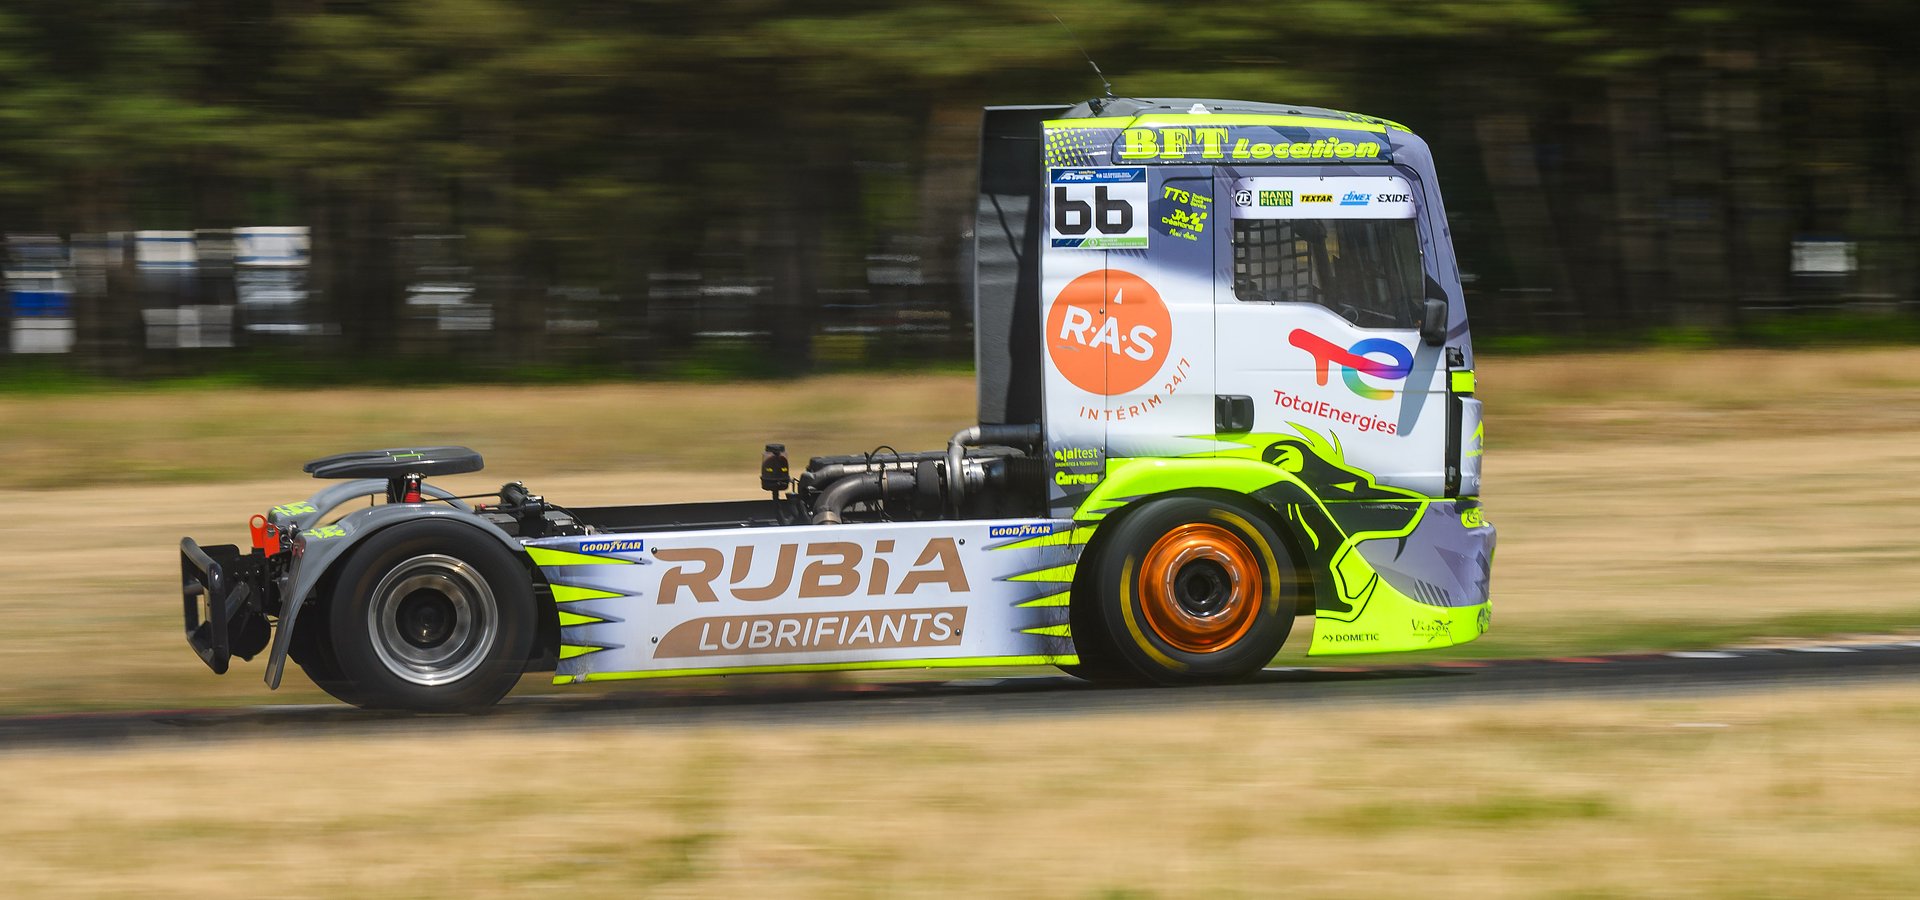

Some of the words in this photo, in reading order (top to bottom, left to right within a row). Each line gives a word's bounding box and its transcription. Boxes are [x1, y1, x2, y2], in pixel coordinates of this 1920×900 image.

[1121, 128, 1230, 159] BFT
[1232, 136, 1381, 159] Location
[1164, 186, 1190, 204] TTS
[1260, 191, 1292, 199] MANN
[1377, 194, 1409, 202] EXIDE
[1260, 198, 1292, 206] FILTER
[1079, 394, 1162, 421] INTÉRIM
[1164, 357, 1191, 395] 24/7
[1273, 389, 1397, 435] TotalEnergies
[991, 524, 1051, 536] GOODYEAR
[581, 540, 641, 552] GOODYEAR
[699, 612, 953, 651] LUBRIFIANTS
[1336, 633, 1379, 642] DOMETIC
